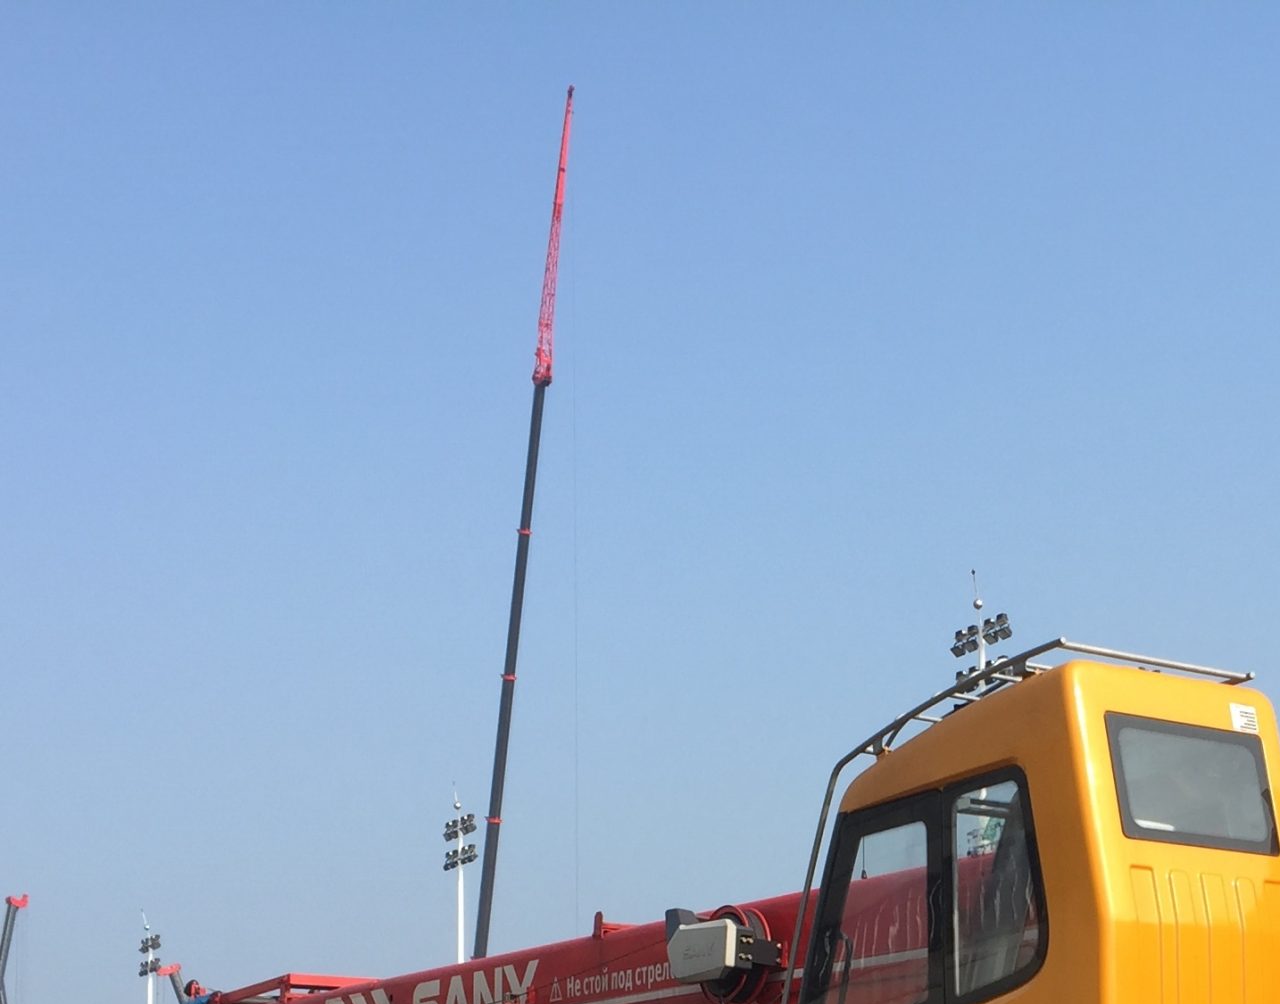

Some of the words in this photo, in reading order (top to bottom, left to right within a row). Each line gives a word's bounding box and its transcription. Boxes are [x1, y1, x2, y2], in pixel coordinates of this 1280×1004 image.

[567, 975, 582, 998] Не
[583, 967, 609, 994] стой
[611, 968, 633, 991] под
